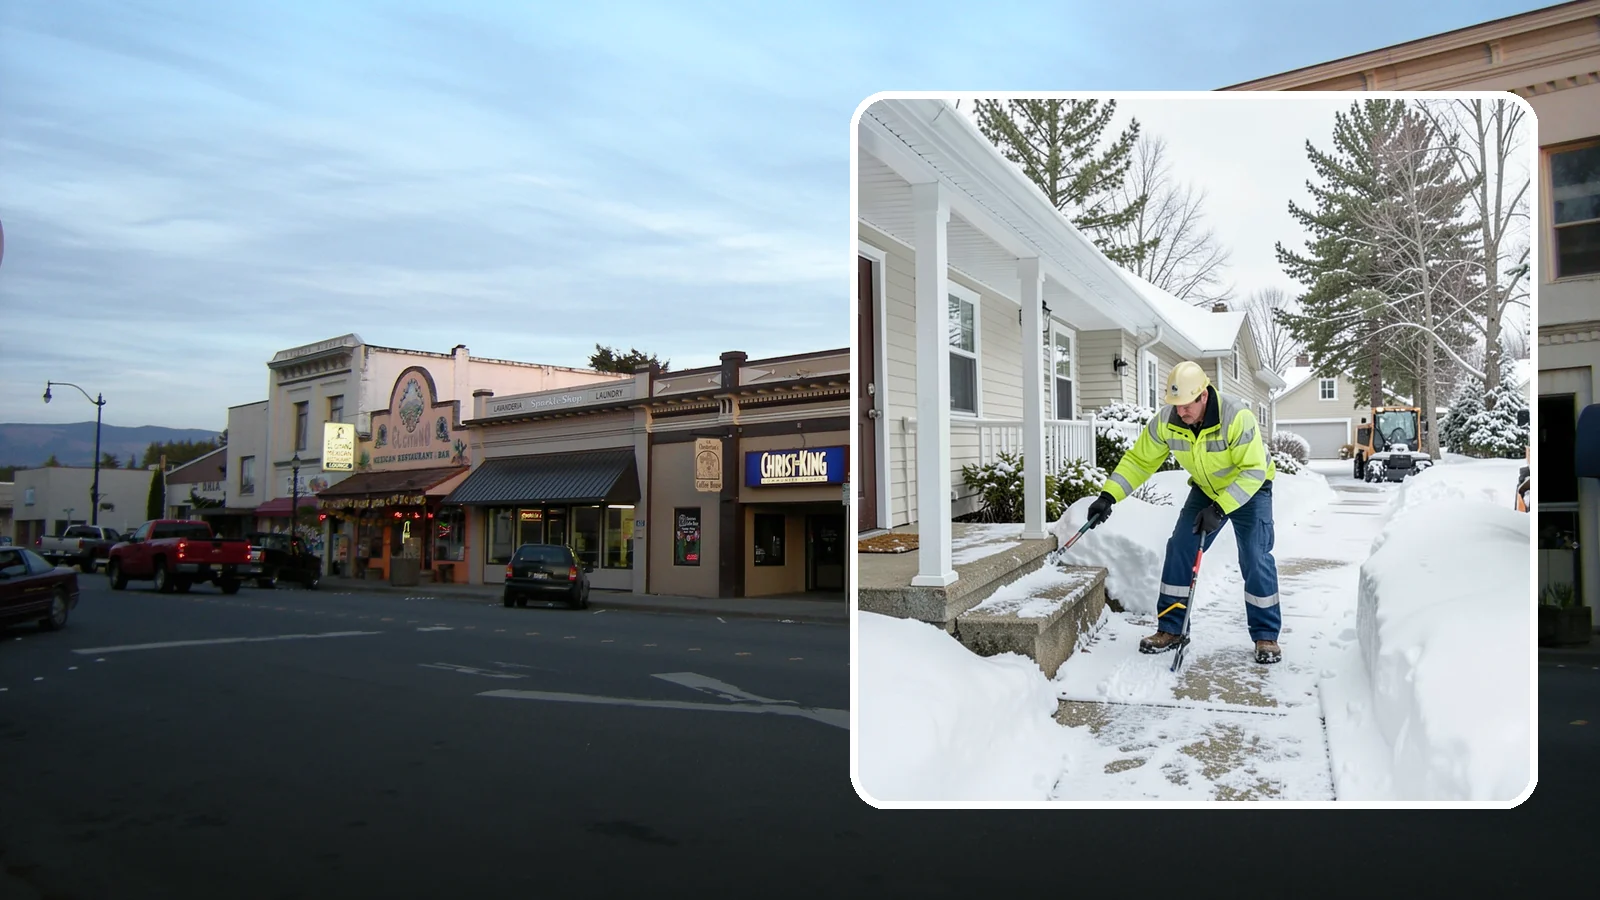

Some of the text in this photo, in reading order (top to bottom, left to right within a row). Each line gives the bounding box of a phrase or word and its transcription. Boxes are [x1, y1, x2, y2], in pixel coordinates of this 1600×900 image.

[595, 389, 624, 400] LAUNDRY
[493, 402, 523, 413] LAVANDERIA
[530, 394, 583, 411] Sparkle Shop
[397, 452, 433, 462] RESTAURANT
[437, 450, 450, 459] BAR
